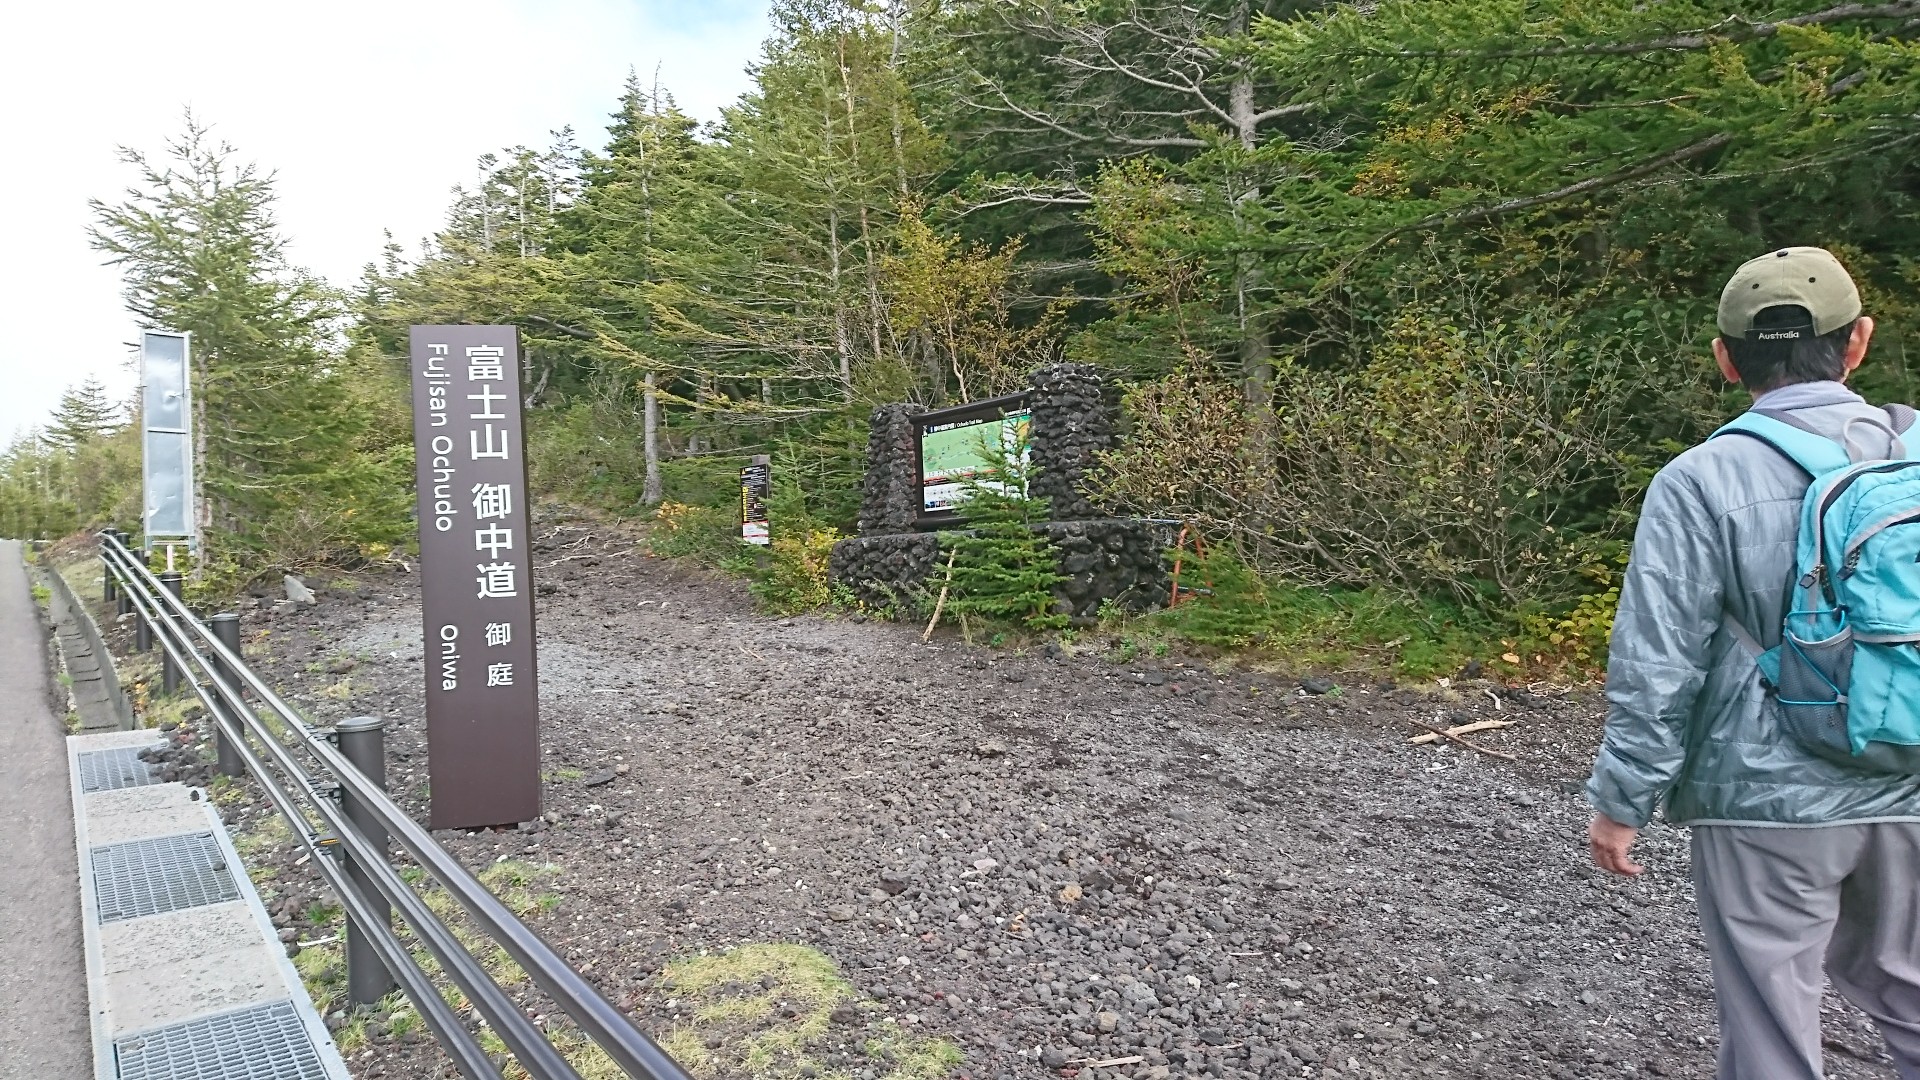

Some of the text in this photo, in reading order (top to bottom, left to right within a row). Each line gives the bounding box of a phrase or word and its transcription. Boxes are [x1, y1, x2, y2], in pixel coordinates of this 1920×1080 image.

[1758, 330, 1800, 340] Australia
[423, 343, 459, 532] Fujisan Ochudo
[465, 344, 518, 600] 富士山 御中道
[440, 624, 461, 691] Oniwa
[484, 622, 514, 687] 御庭
